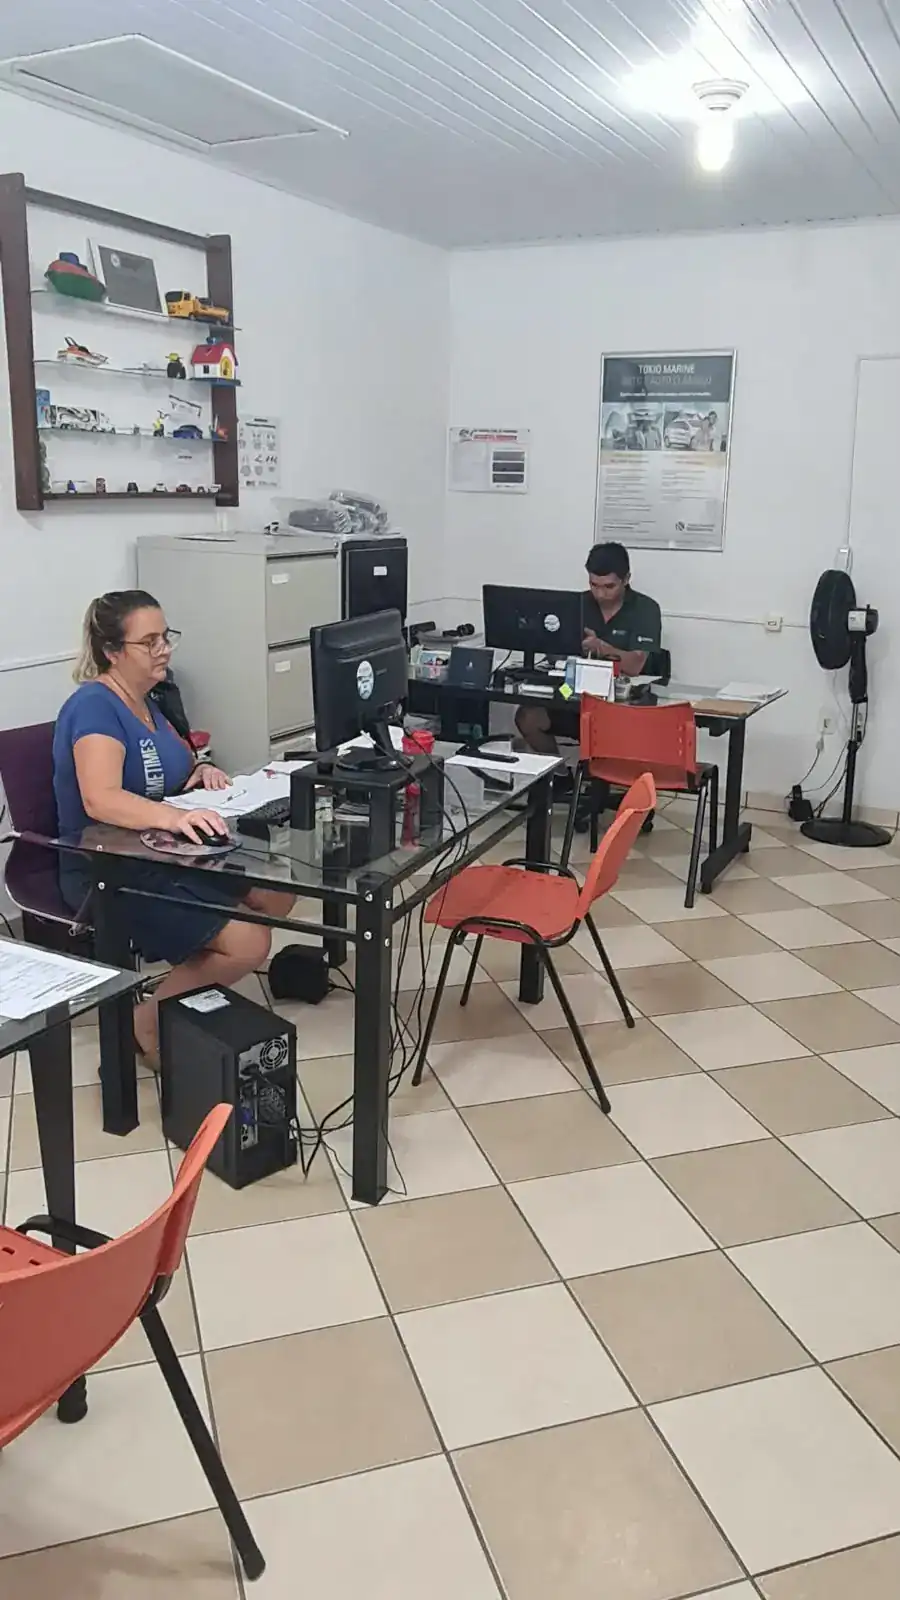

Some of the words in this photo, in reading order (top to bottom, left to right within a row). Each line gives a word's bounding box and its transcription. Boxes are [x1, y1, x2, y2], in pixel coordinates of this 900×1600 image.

[638, 364, 661, 374] TOKIO
[662, 363, 695, 374] MARINE
[139, 738, 165, 798] OMETIMES
